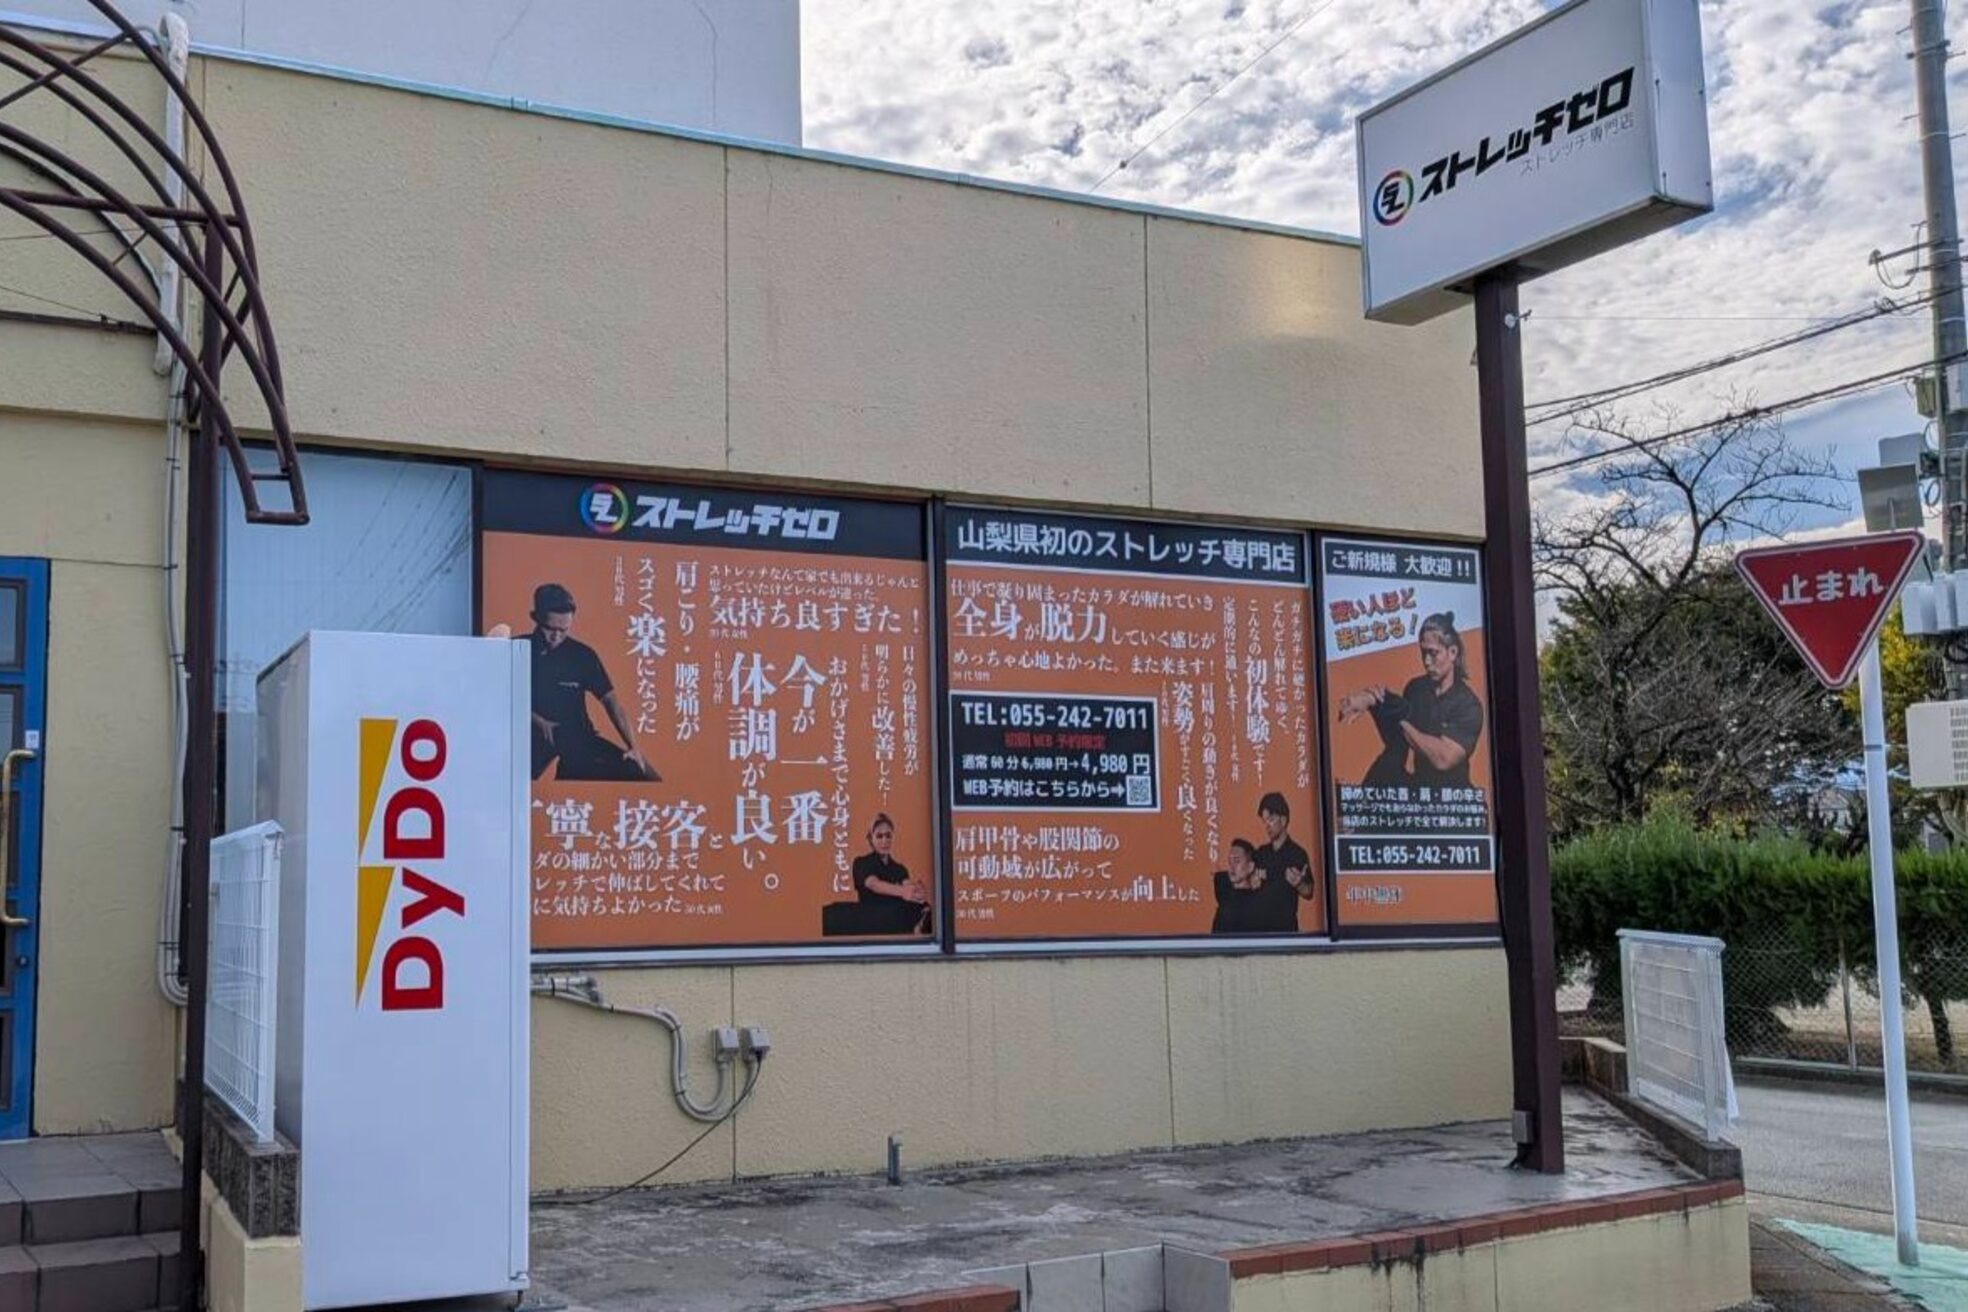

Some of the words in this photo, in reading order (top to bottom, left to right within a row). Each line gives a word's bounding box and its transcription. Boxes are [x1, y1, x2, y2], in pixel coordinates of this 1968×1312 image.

[1418, 66, 1635, 202] ストレッチゼロ
[632, 495, 840, 540] ストレッチゼロ
[957, 519, 1297, 573] 山梨県初のストレッチ専門店
[1332, 550, 1397, 574] ご新規様
[1405, 556, 1452, 577] 大歓迎
[1779, 567, 1884, 605] 止まれ
[626, 557, 667, 734] スゴく楽になった
[675, 561, 701, 741] 肩こり・腰痛が
[962, 702, 1148, 729] TEL:055-242-7011
[780, 654, 829, 844] 今が一番
[828, 655, 851, 893] おかげさまで心身ともに
[532, 797, 724, 851] 寧な接客と
[956, 826, 1120, 852] 肩甲骨や股関節の
[381, 718, 465, 1011] DyDo
[958, 854, 1112, 881] 可動域が広がって
[1350, 845, 1480, 865] TEL:055-242-7011
[535, 873, 726, 893] レッチで伸ばしてくれて
[533, 896, 682, 917] に気持ちよかった
